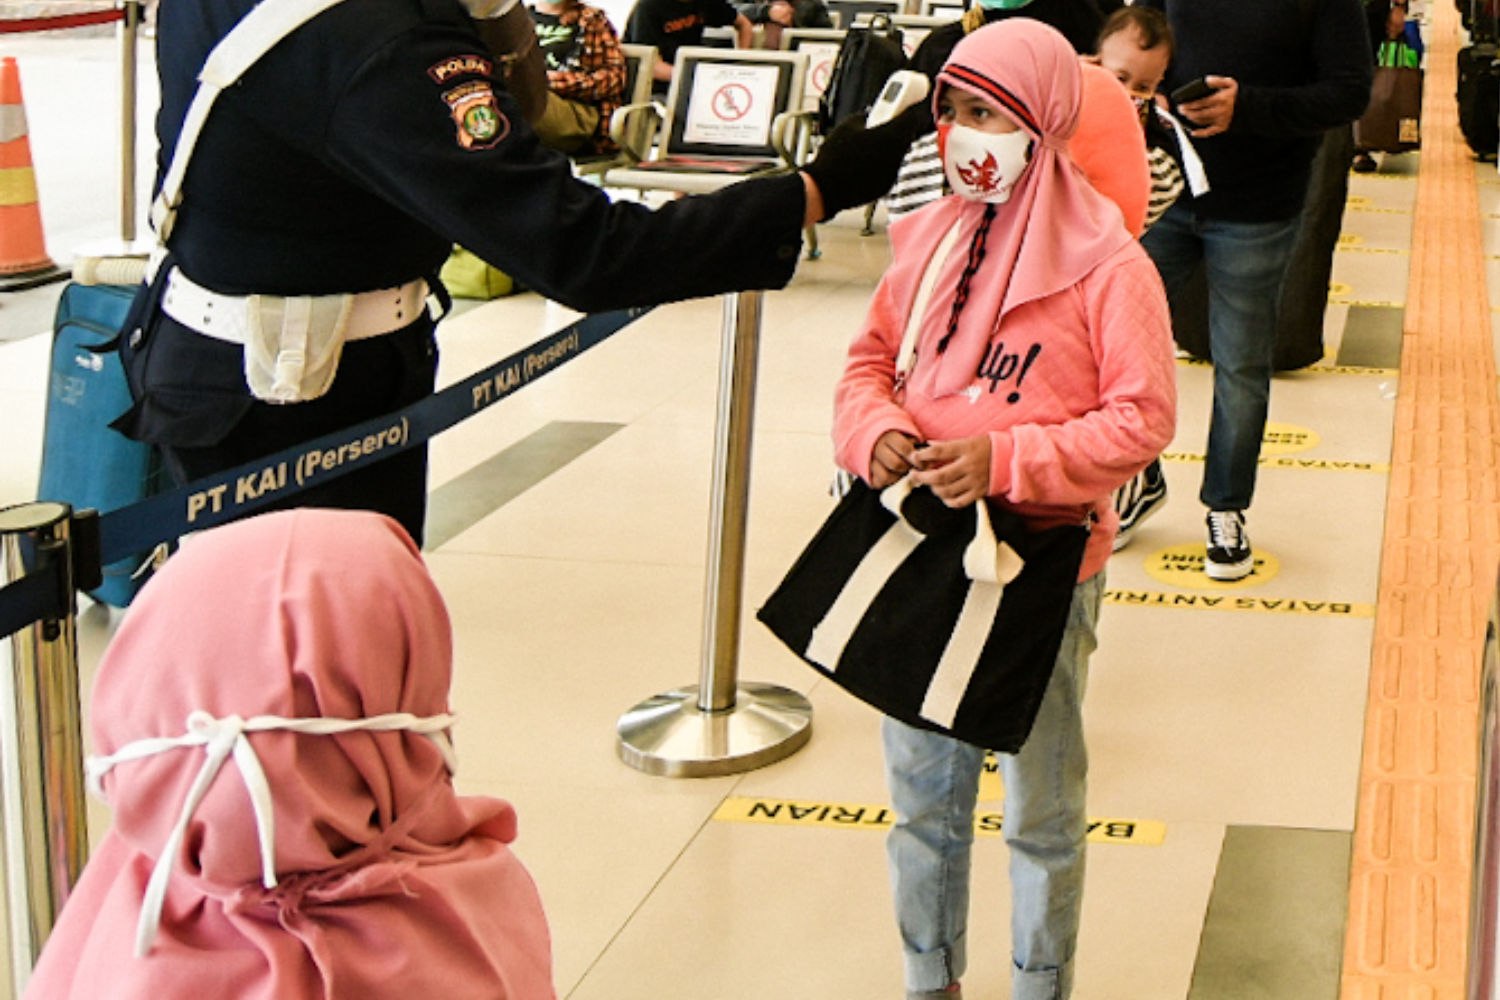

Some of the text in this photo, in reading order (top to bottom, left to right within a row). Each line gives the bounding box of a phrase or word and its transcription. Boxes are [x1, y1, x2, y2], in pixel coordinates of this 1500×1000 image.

[471, 327, 580, 410] PT KAI (Persero)
[187, 416, 409, 523] PT KAI (Persero)
[1235, 598, 1352, 614] BATAS
